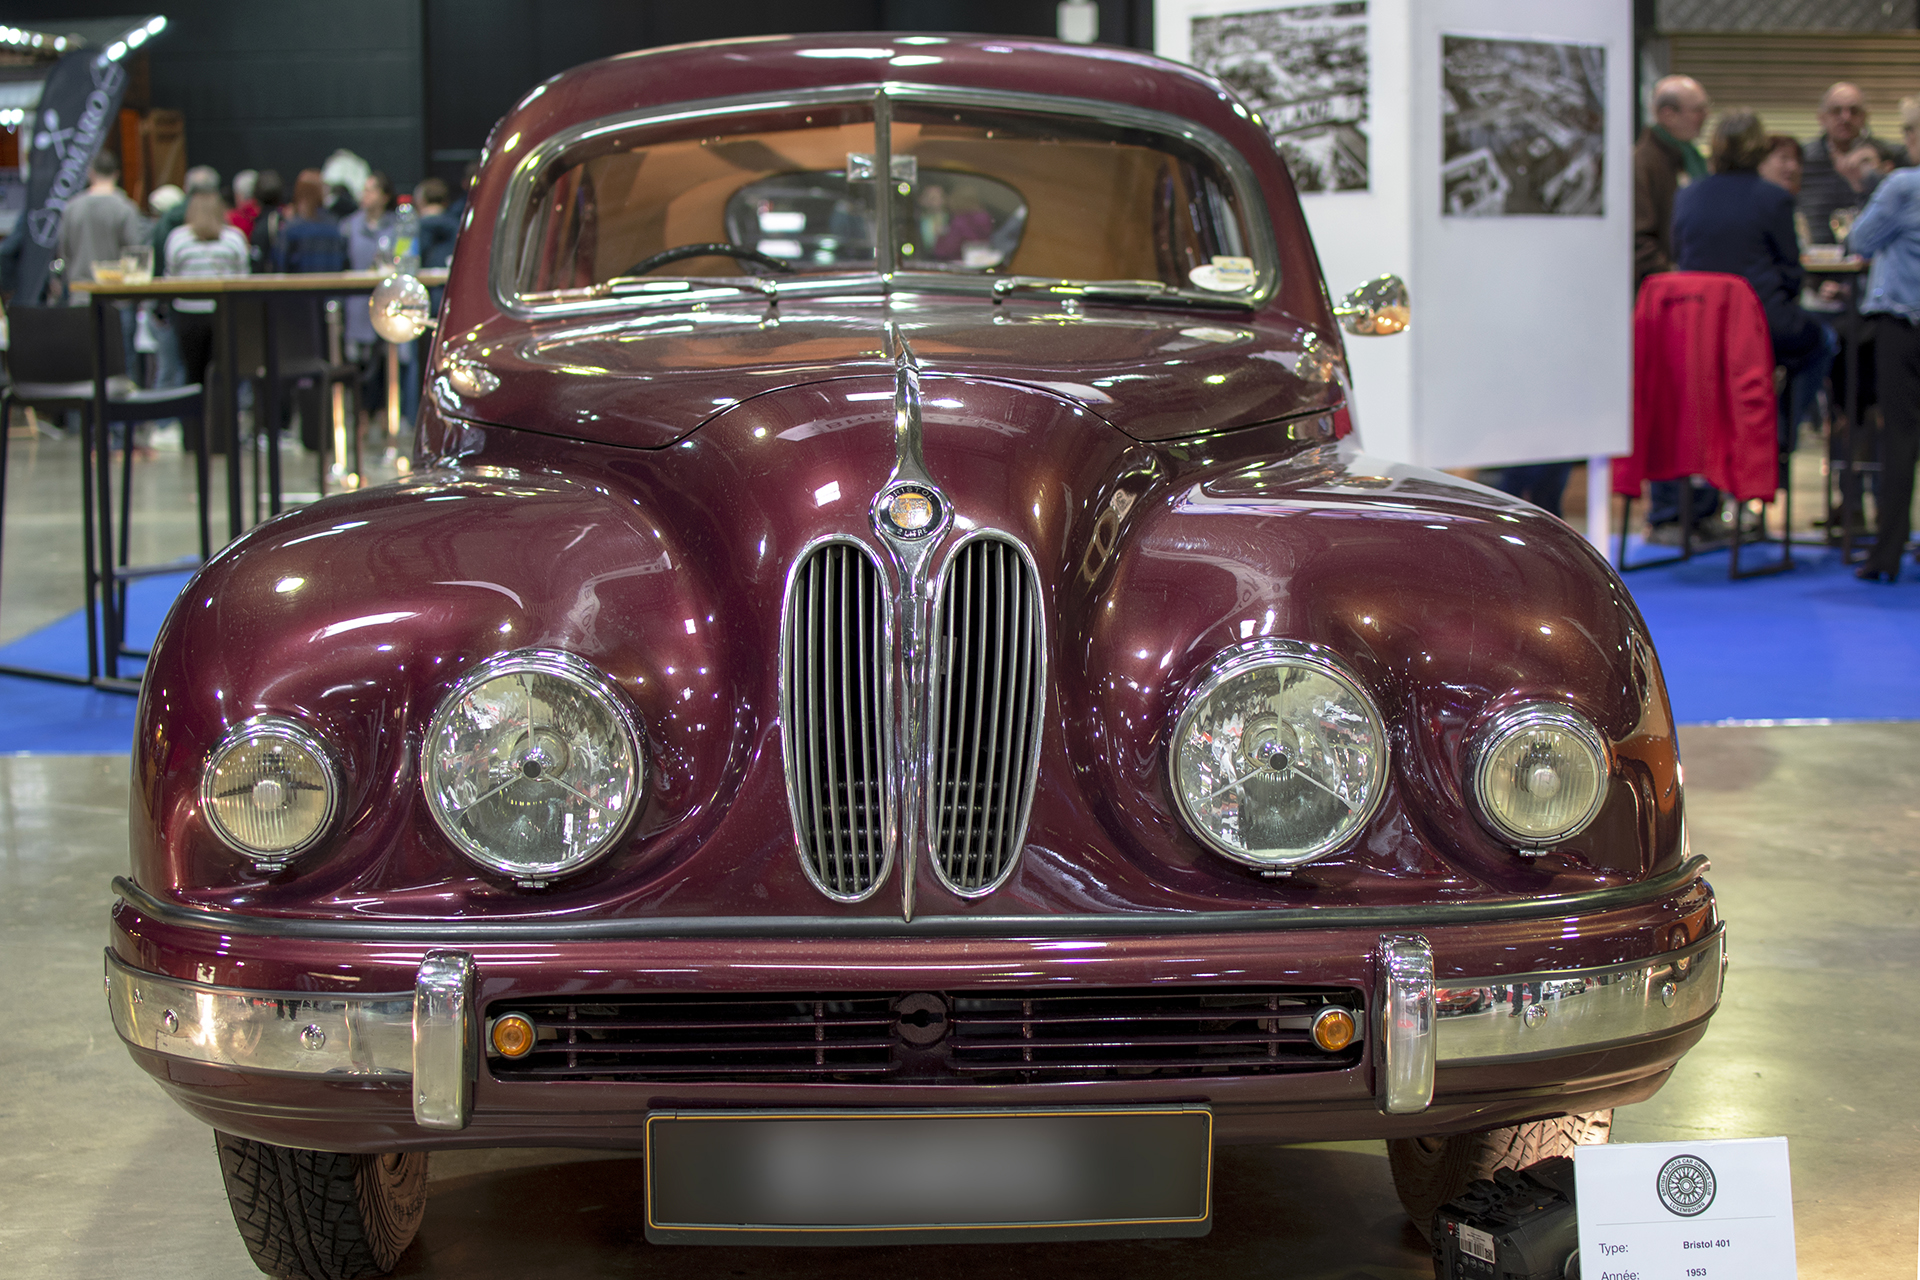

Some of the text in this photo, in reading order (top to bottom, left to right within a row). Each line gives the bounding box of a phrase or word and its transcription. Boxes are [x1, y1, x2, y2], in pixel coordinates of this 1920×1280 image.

[888, 486, 933, 502] BRISTOL
[1664, 1160, 1681, 1175] SPORTS
[1694, 1161, 1711, 1180] OWNERS
[1669, 1202, 1706, 1213] LUXEMBOURG
[1598, 1242, 1629, 1256] Type:
[1683, 1239, 1731, 1250] Bristol 401
[1601, 1269, 1640, 1280] Année:
[1686, 1268, 1707, 1277] 1953
